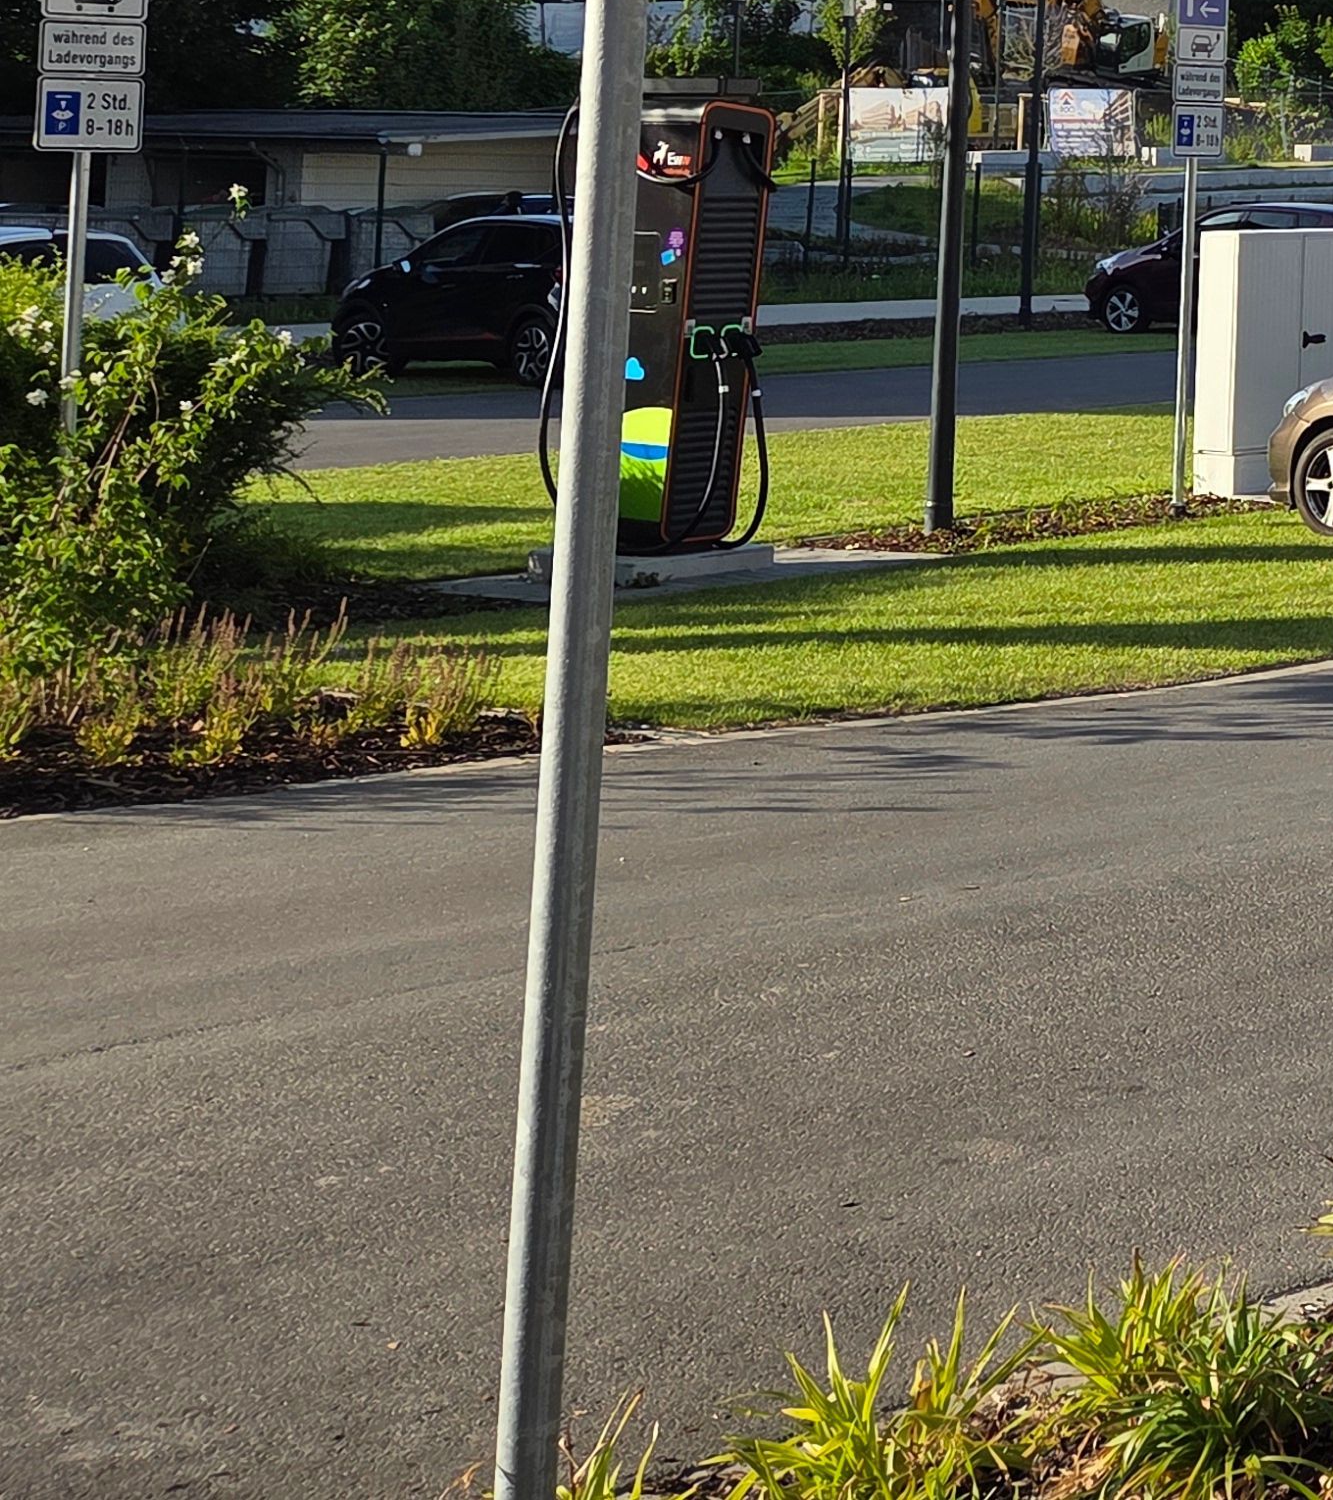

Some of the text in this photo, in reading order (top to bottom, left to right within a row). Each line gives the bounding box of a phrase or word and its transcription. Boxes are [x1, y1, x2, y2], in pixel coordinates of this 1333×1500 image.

[52, 30, 135, 46] während des
[48, 48, 136, 69] Ladevorgangs
[86, 92, 132, 111] 2 Std.
[1196, 115, 1202, 128] 2
